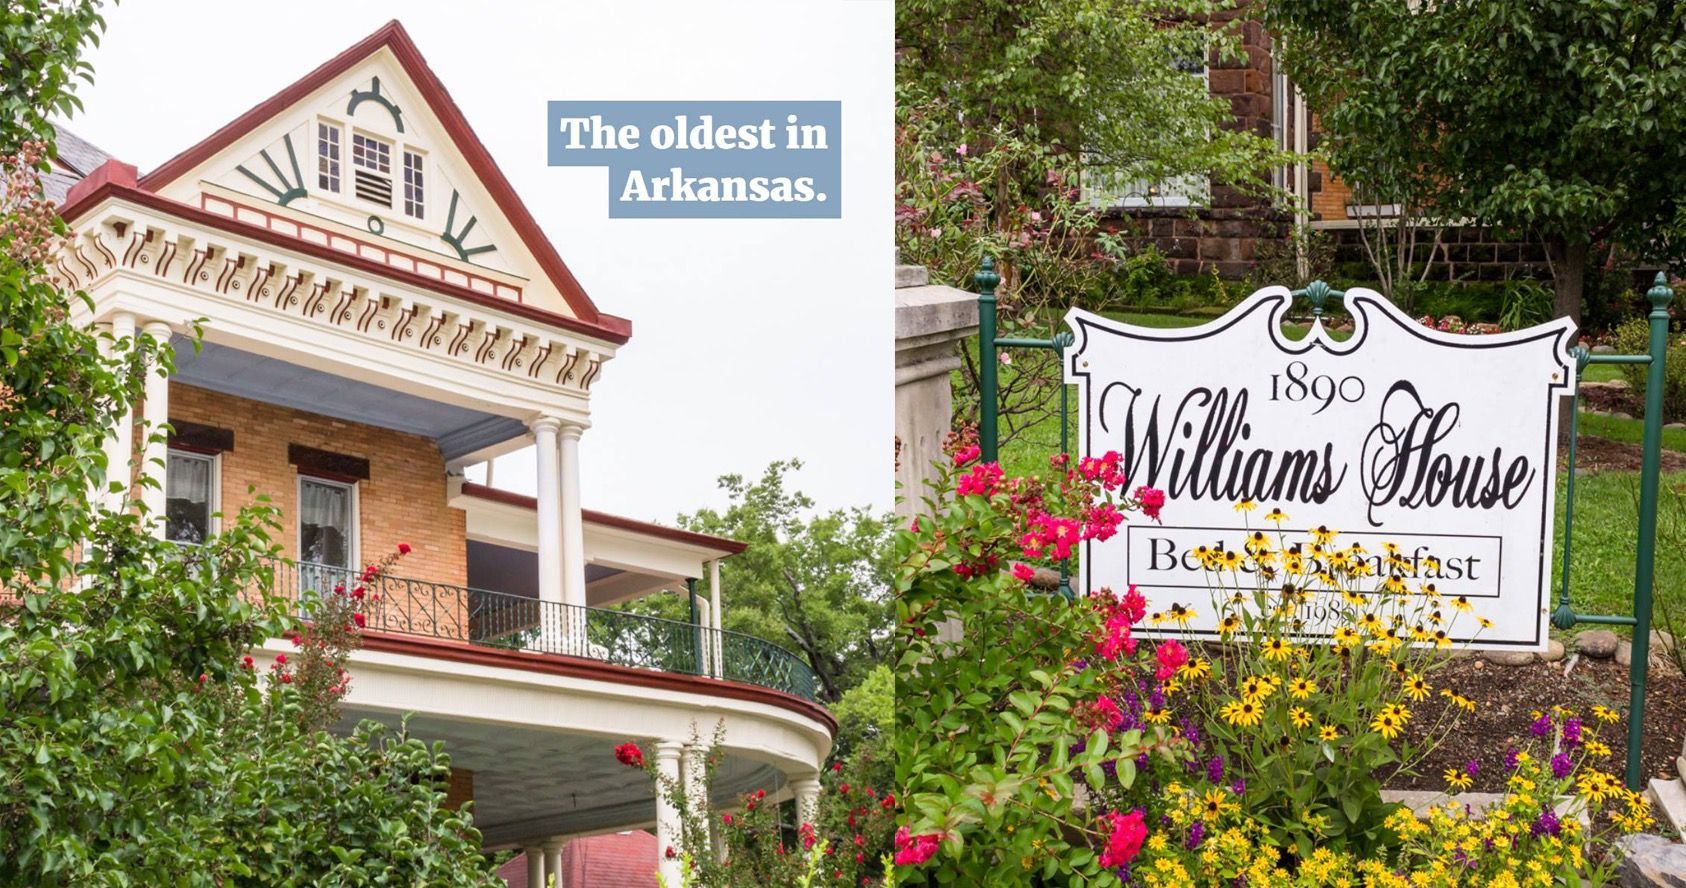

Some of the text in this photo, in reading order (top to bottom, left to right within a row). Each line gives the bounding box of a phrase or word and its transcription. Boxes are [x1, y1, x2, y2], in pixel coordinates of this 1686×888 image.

[1269, 360, 1365, 415] 1890
[1099, 380, 1536, 527] Williams House
